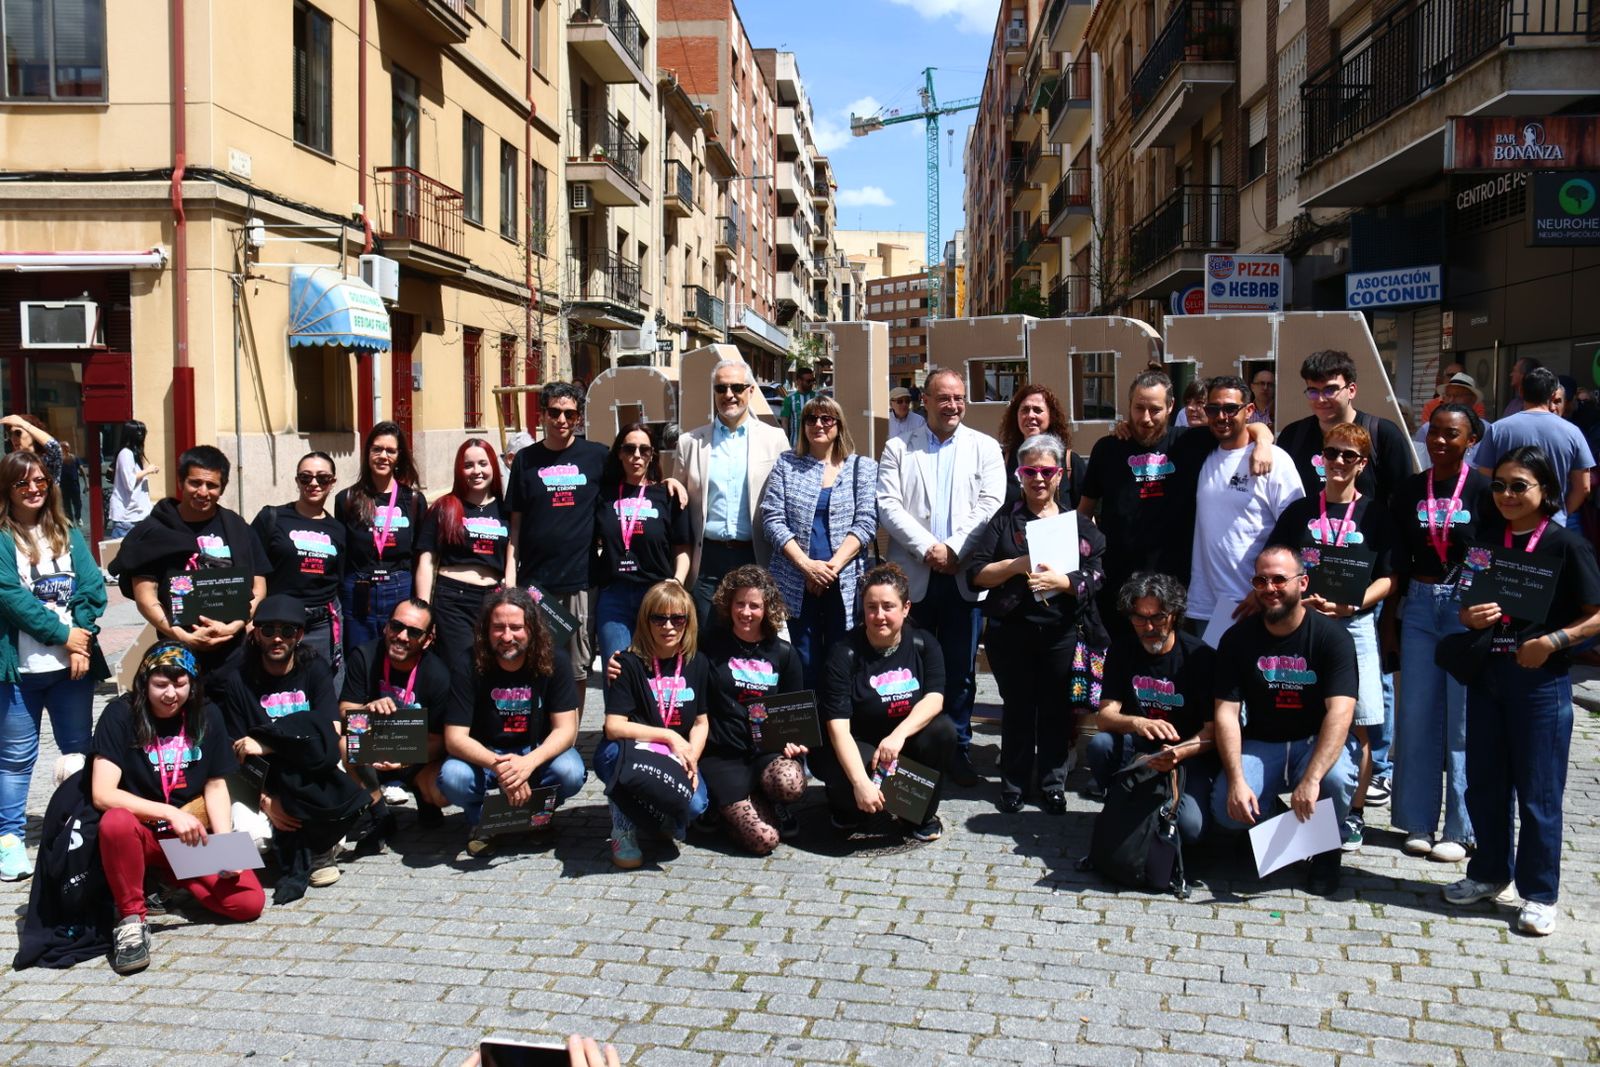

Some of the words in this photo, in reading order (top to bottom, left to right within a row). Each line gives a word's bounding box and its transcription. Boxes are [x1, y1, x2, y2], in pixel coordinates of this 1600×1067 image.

[1496, 134, 1516, 146] BAR
[1493, 144, 1563, 160] BONANZA
[1457, 180, 1496, 210] CENTRO
[1497, 173, 1512, 196] DE
[1238, 262, 1279, 277] PIZZA
[1356, 270, 1430, 290] ASOCIACIÓN
[1230, 281, 1279, 298] KEBAB
[1349, 284, 1439, 306] COCONUT
[633, 763, 662, 776] BARRIO
[663, 773, 676, 785] DEL
